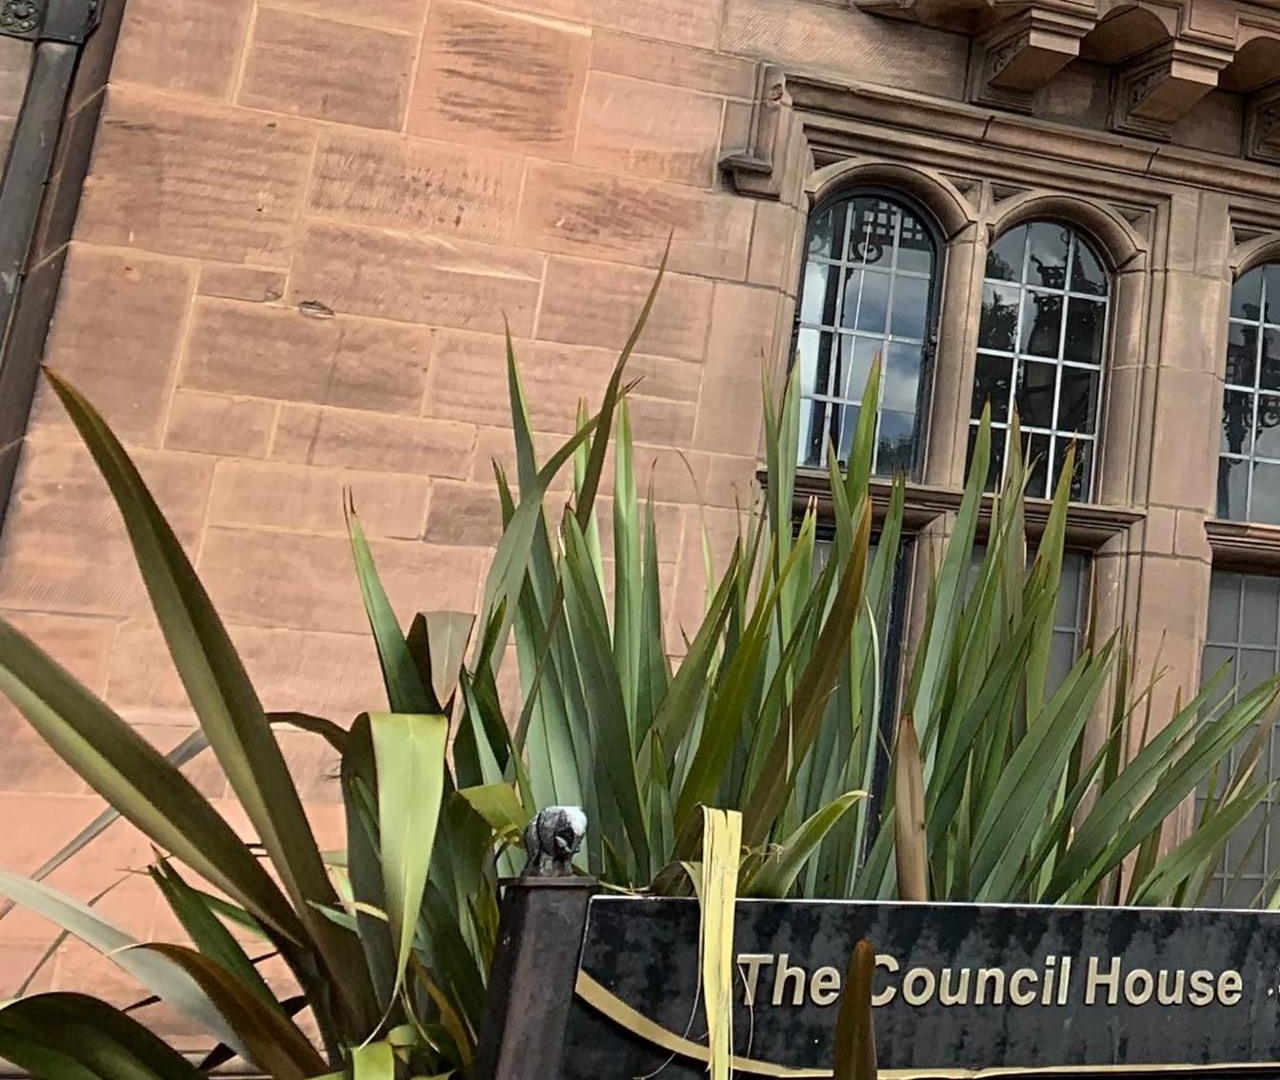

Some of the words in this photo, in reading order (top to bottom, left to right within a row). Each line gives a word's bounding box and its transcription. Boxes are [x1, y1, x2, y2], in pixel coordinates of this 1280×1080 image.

[736, 953, 841, 1006] The
[869, 954, 1071, 1007] Council
[1085, 956, 1243, 1007] House
